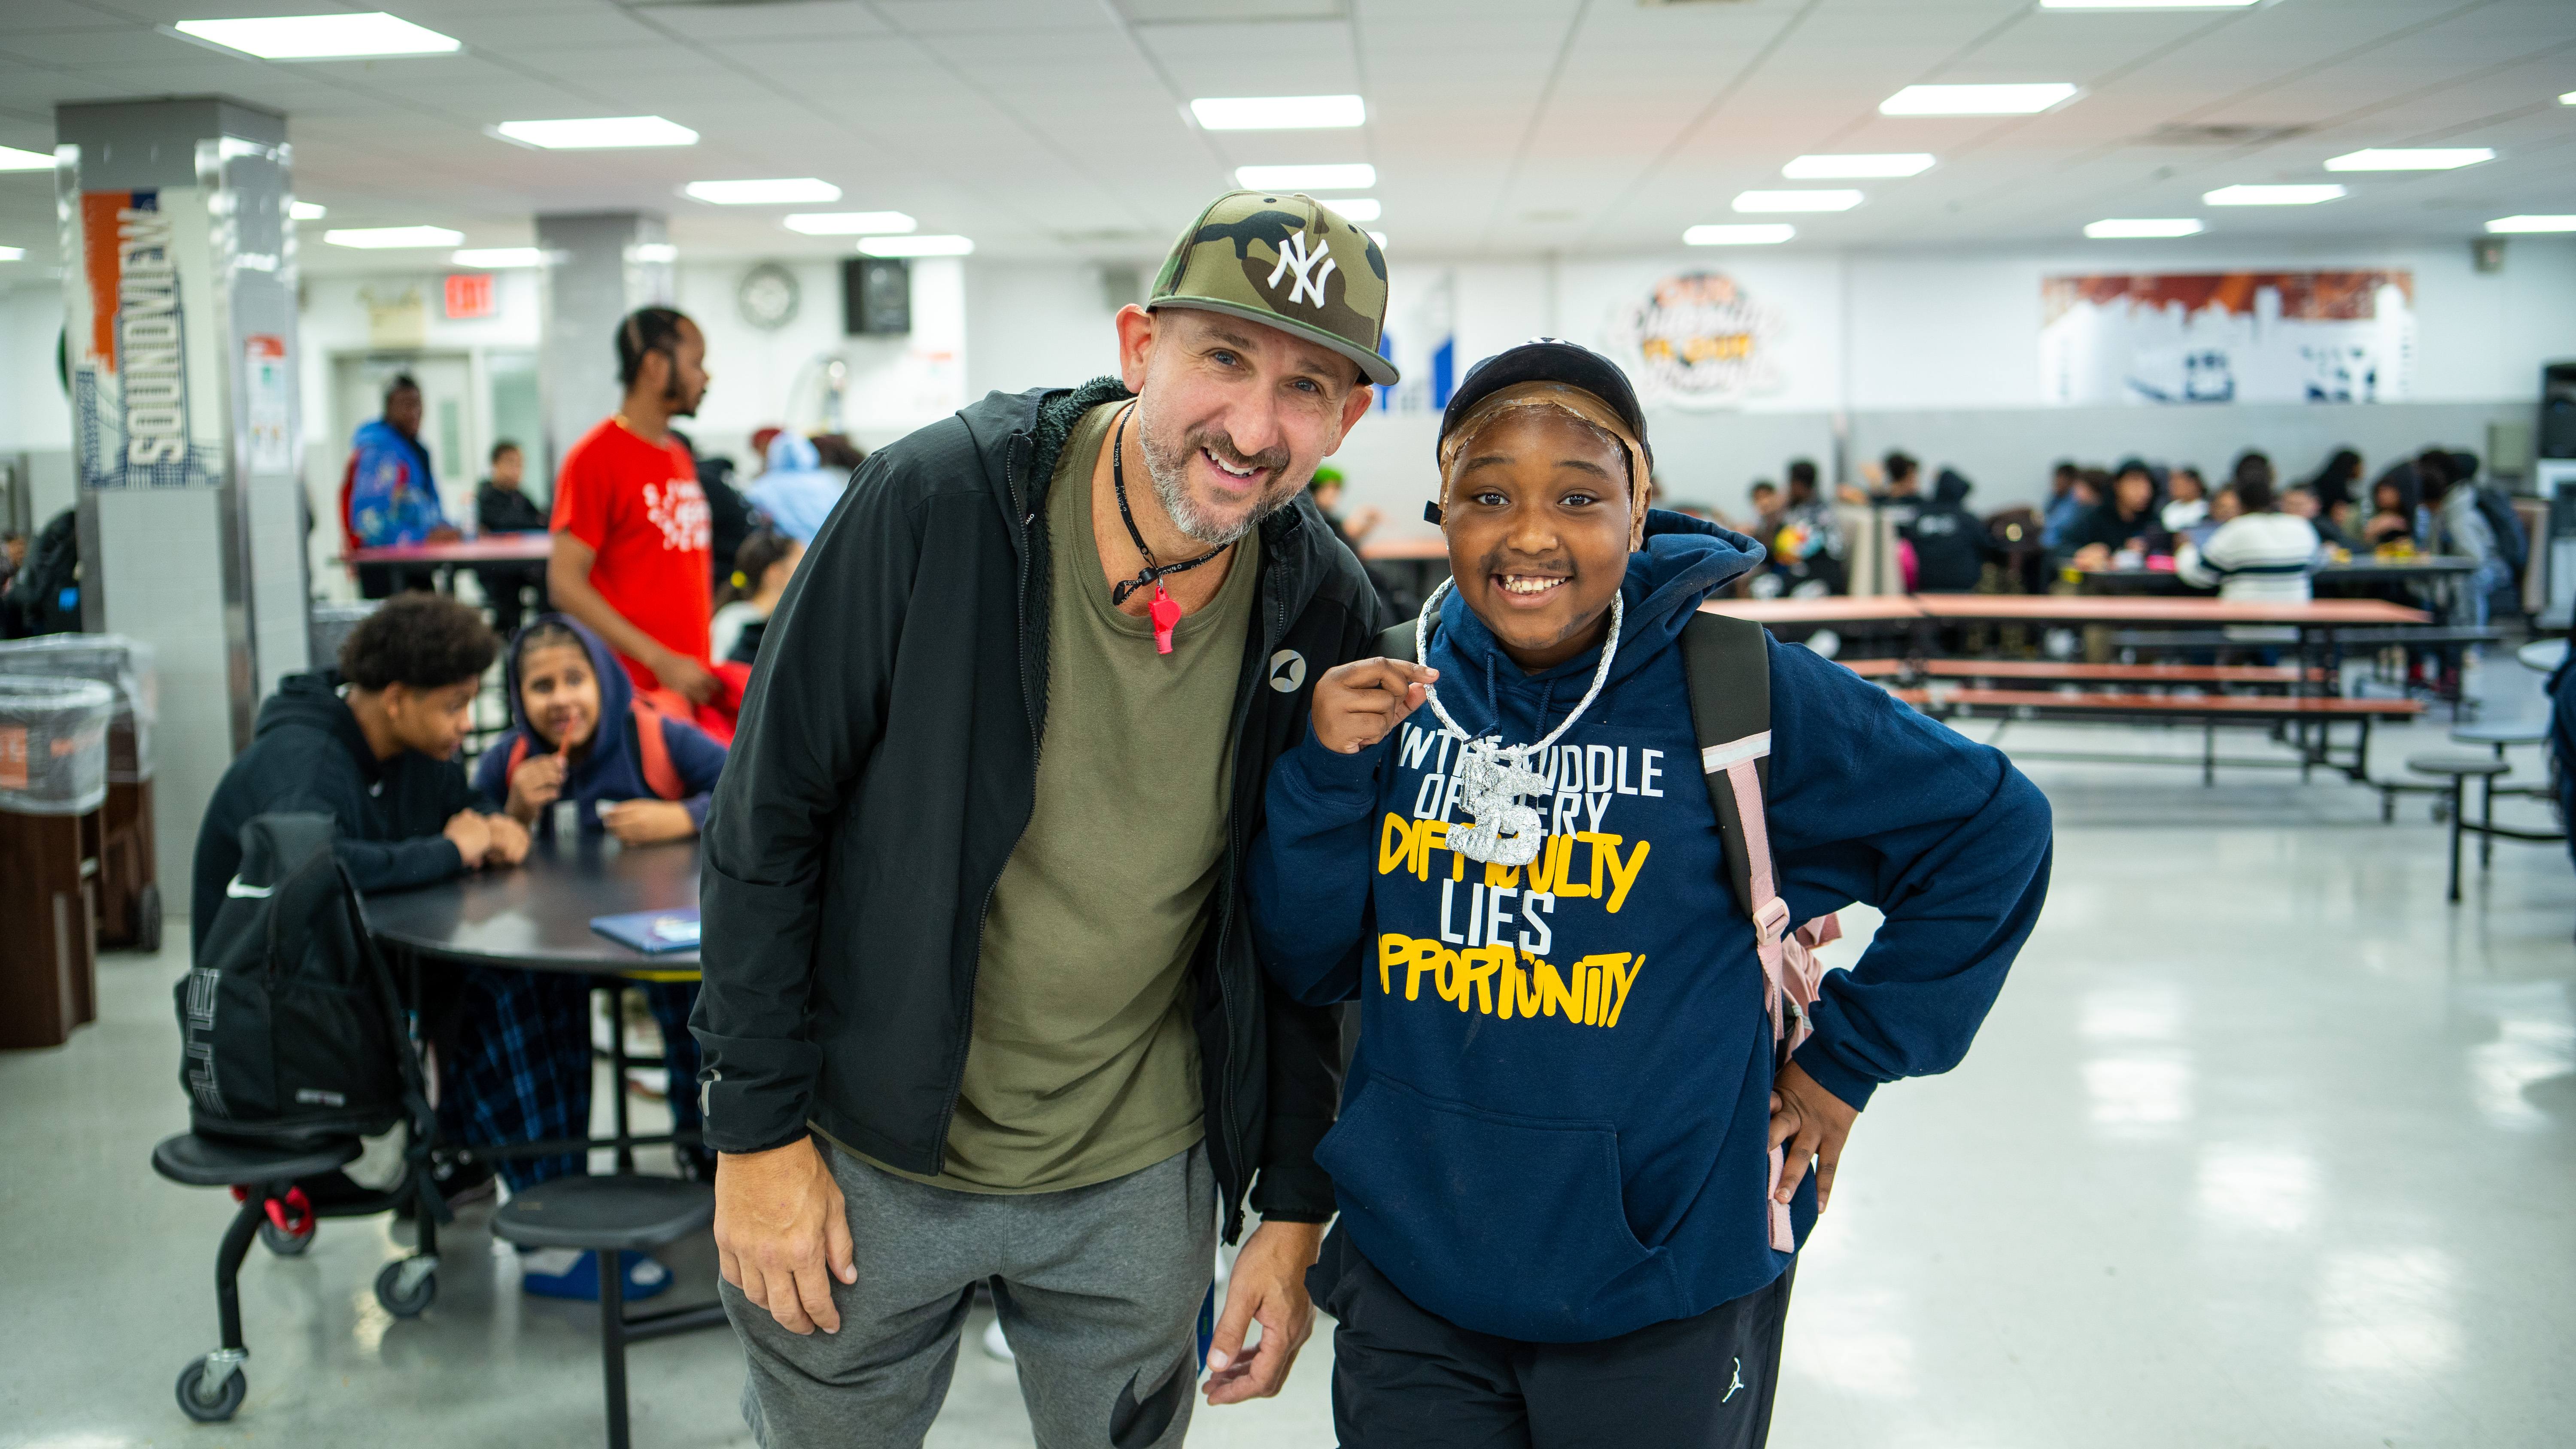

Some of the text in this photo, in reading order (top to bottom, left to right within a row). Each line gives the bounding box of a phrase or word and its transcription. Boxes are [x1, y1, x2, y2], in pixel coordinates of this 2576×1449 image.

[1267, 230, 1336, 309] NY
[116, 208, 184, 466] SOUNDVIEW
[1441, 878, 1555, 955] LIES
[1378, 932, 1646, 1028] PPORTUNITY
